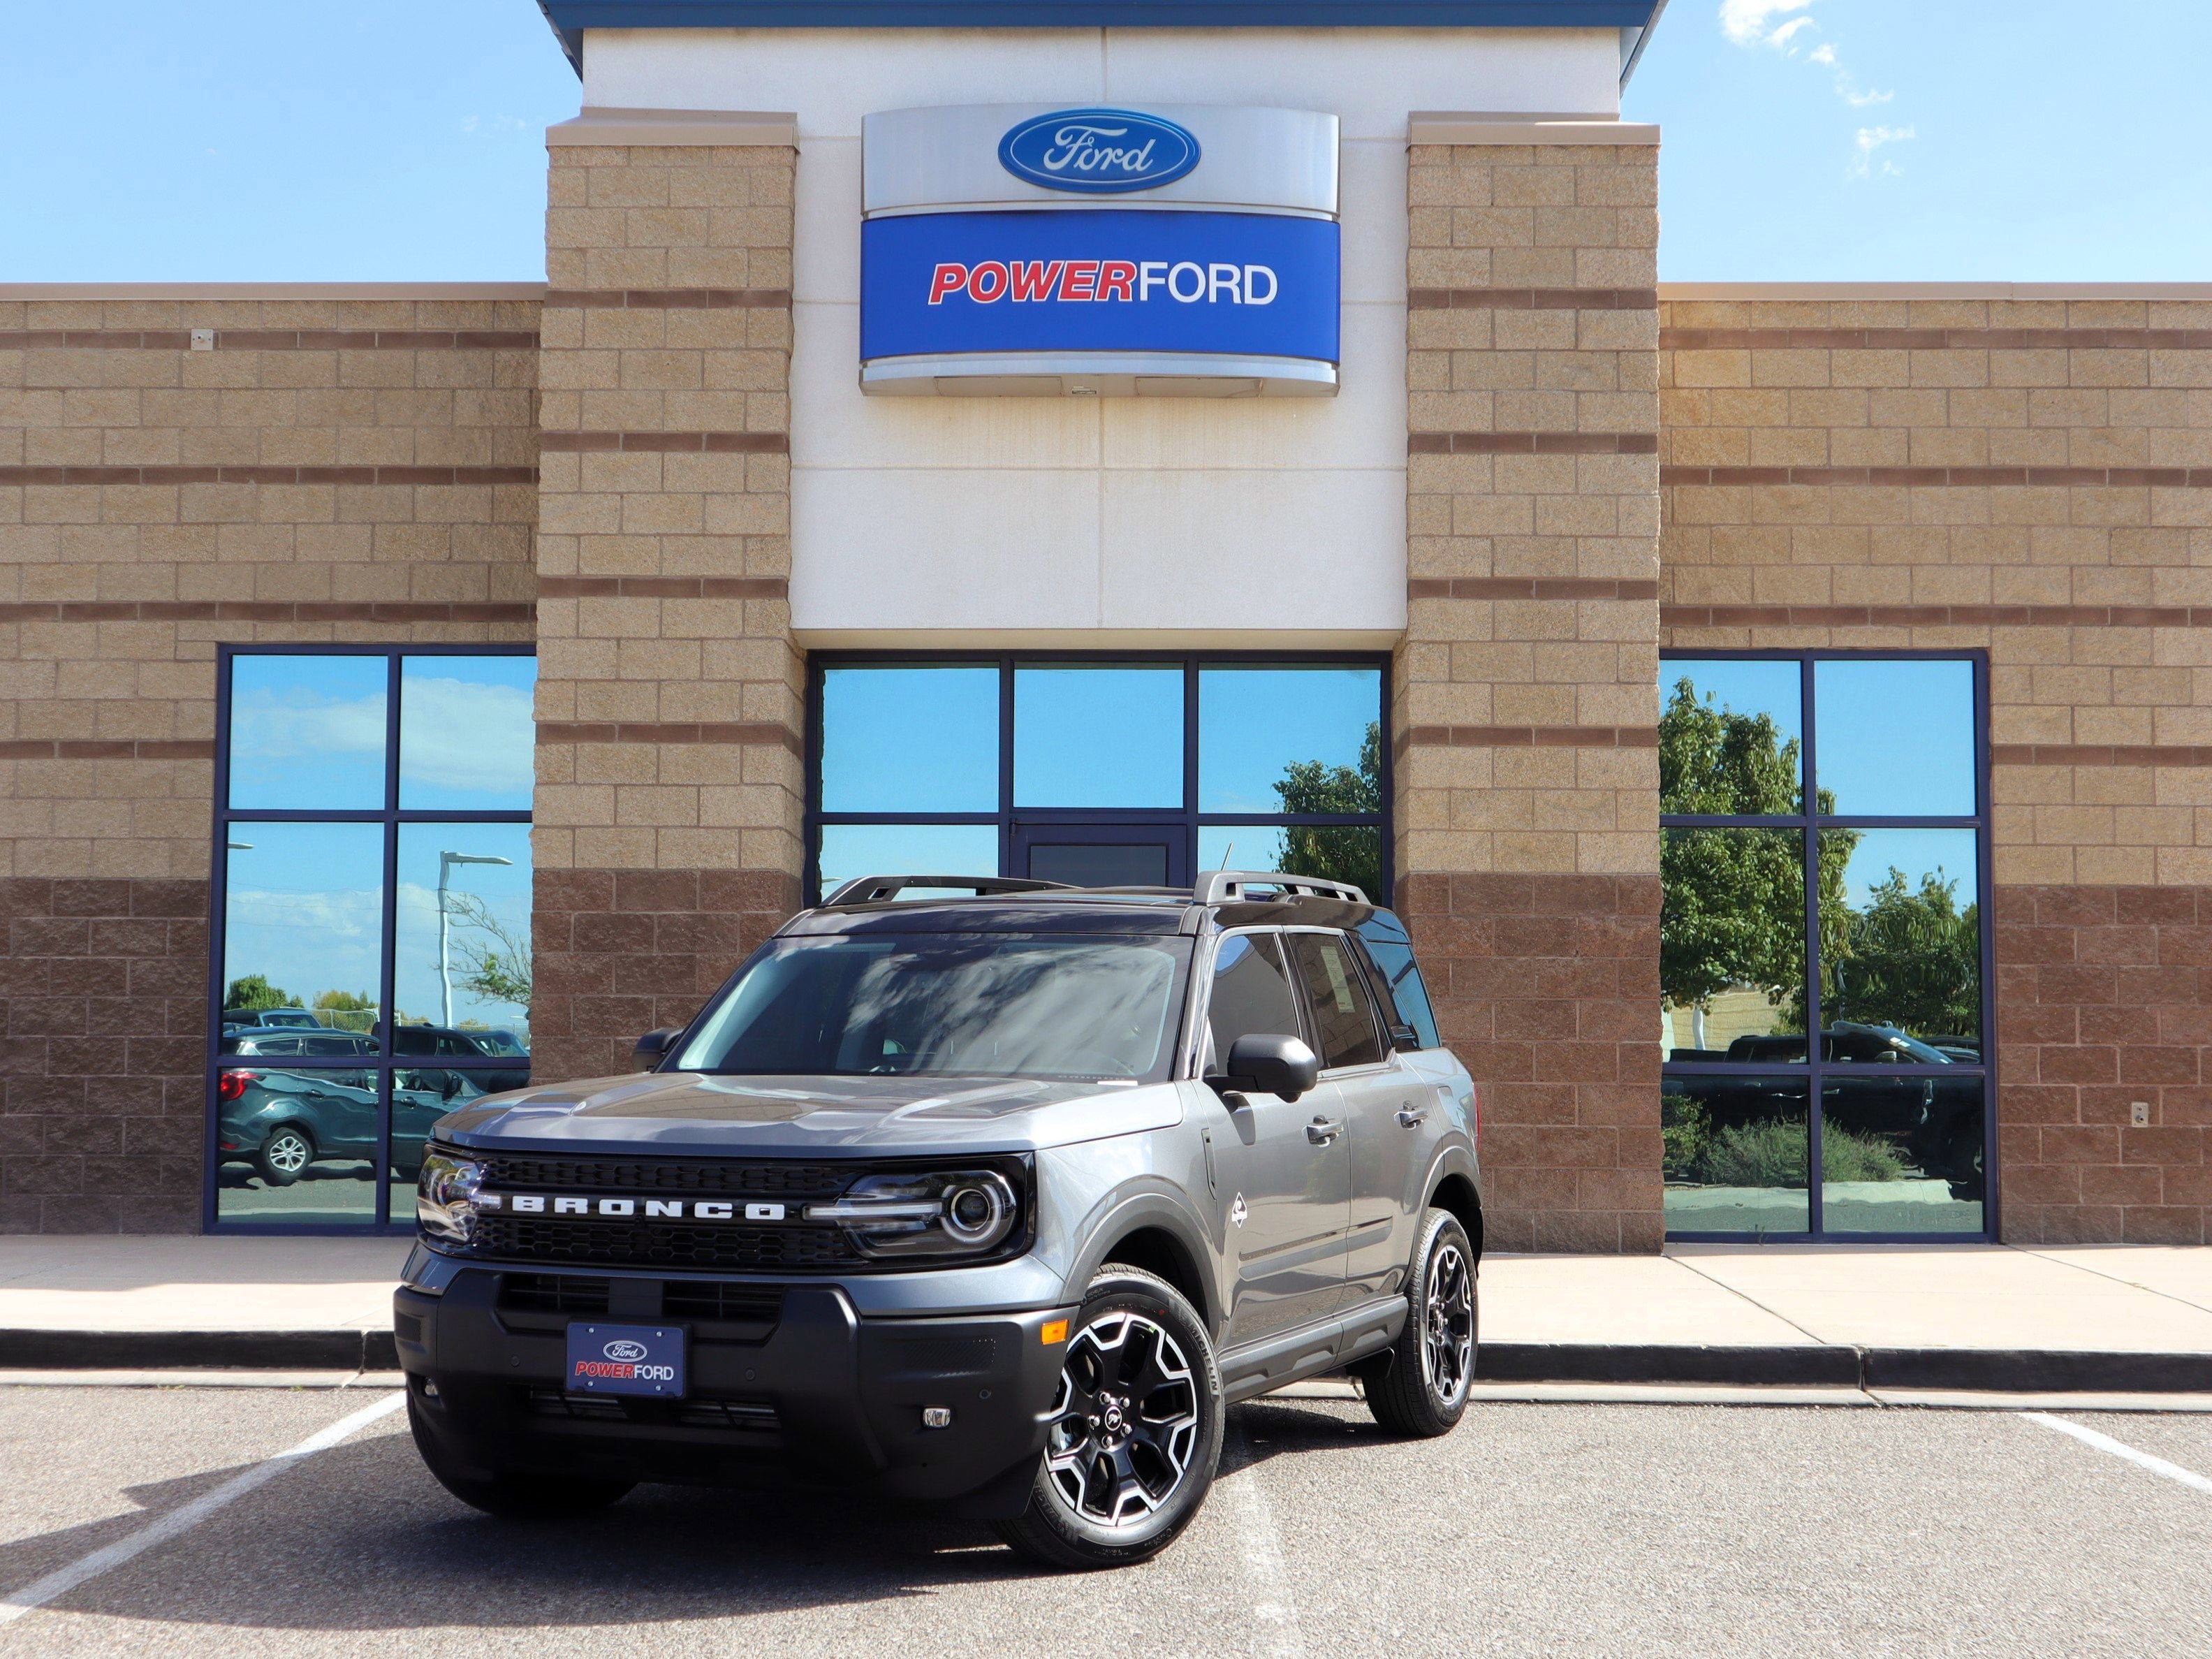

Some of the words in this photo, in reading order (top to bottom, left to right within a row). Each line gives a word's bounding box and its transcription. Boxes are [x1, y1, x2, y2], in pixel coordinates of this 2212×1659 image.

[1043, 125, 1156, 171] Ford
[512, 1195, 785, 1220] BRONCO
[612, 1344, 638, 1358] Ford
[1189, 1322, 1218, 1391] MICHELIN
